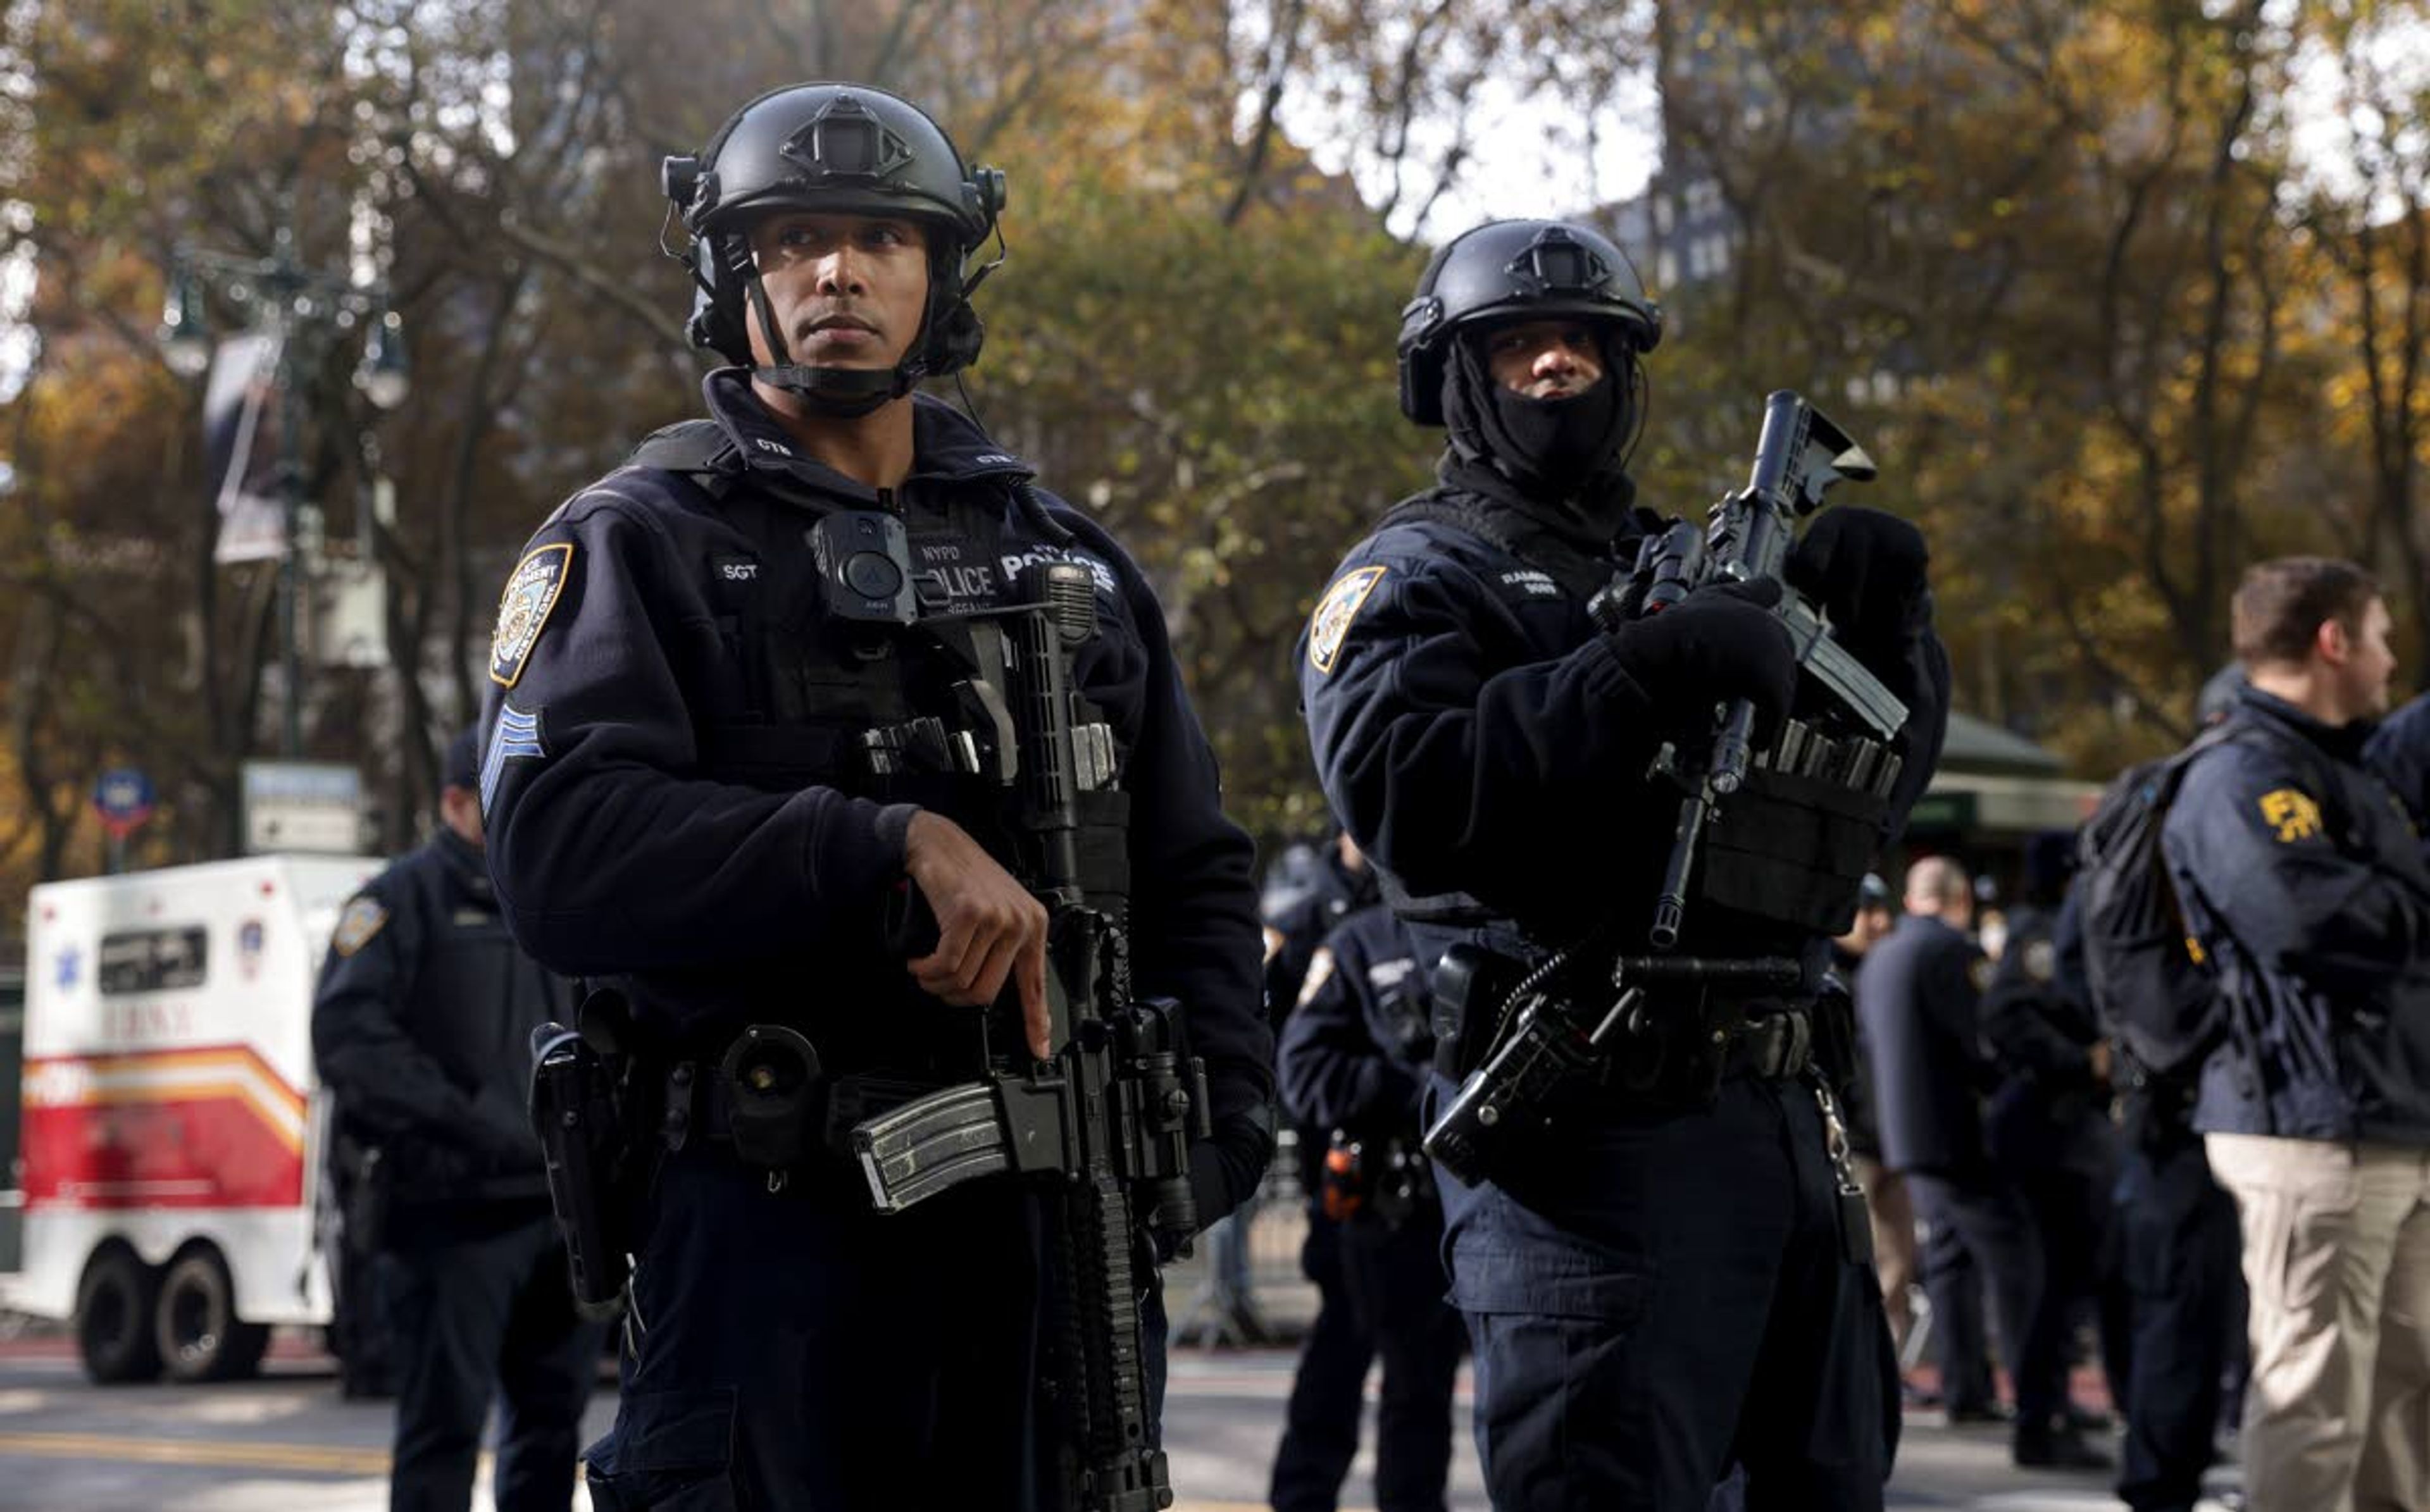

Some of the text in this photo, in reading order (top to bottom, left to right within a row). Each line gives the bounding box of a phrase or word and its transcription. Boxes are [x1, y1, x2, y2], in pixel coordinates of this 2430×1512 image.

[921, 545, 960, 561] NYPD
[722, 564, 757, 580] SGT
[926, 567, 996, 596] OLICE
[1000, 552, 1115, 592] POCE
